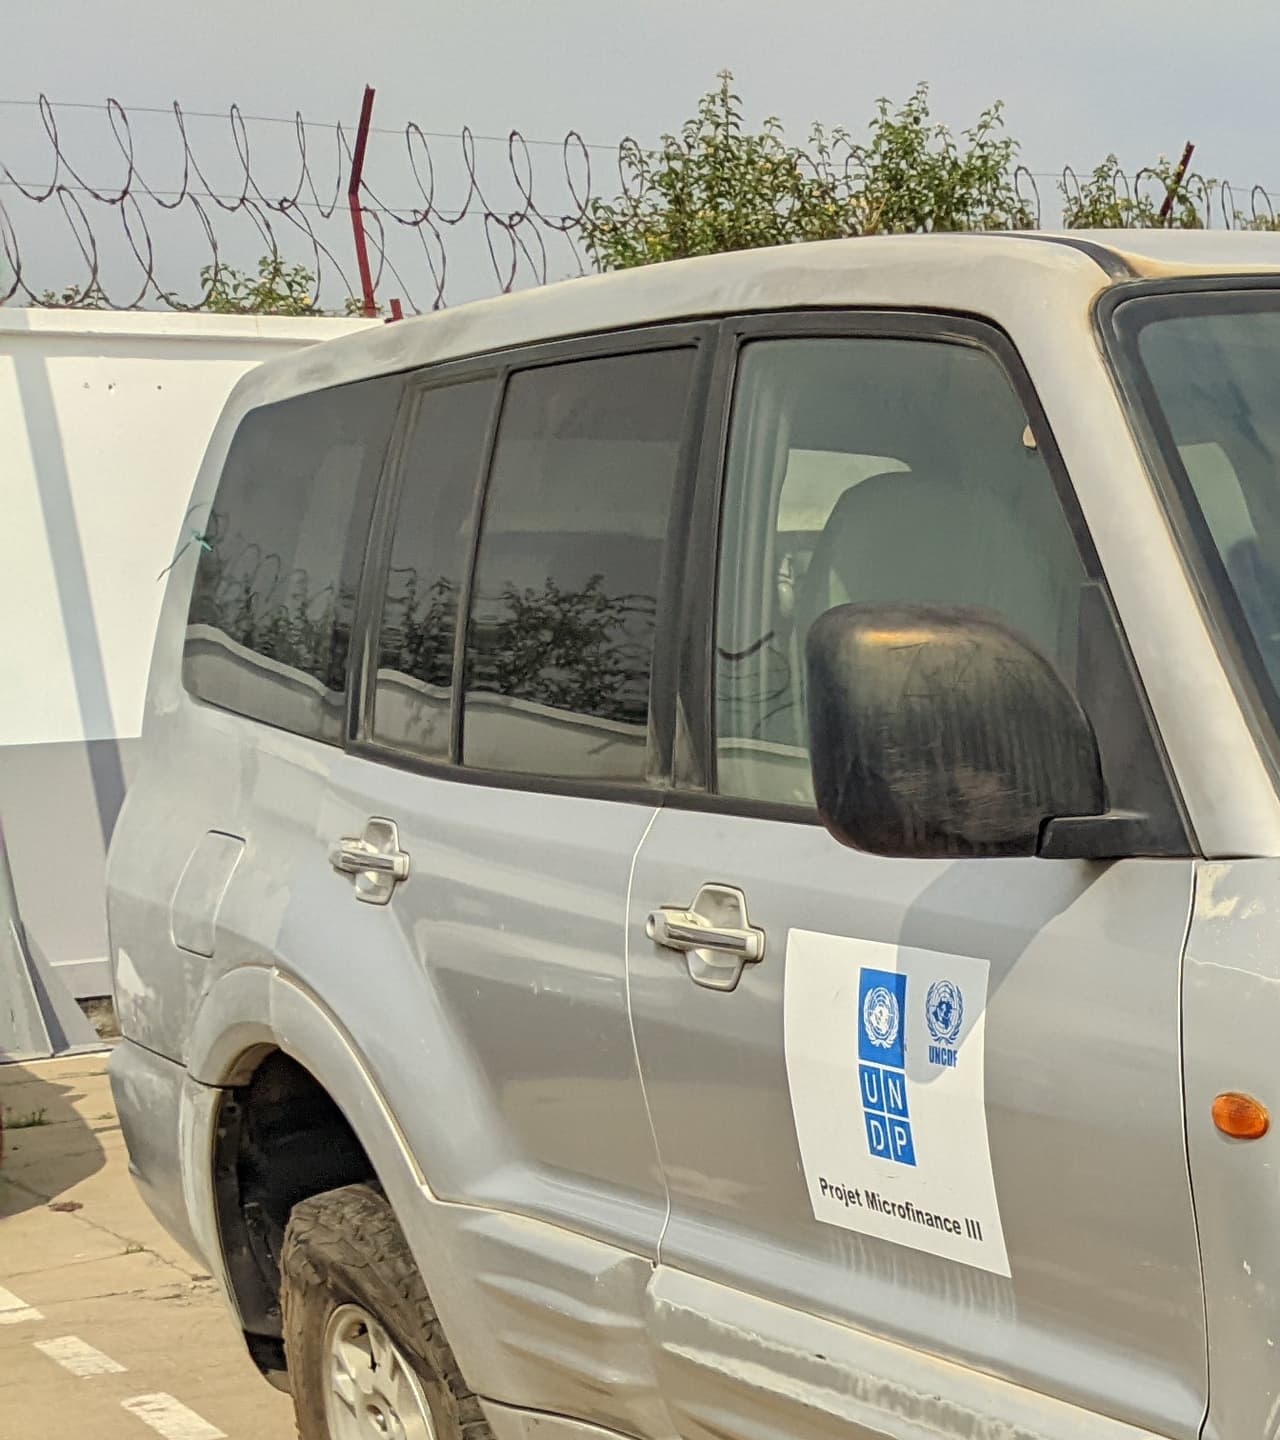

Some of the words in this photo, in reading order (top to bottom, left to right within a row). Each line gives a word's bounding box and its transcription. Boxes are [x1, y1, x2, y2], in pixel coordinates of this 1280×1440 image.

[929, 1046, 957, 1067] UNCDF
[819, 1177, 862, 1207] Projet
[864, 1190, 962, 1235] Microfinance
[966, 1220, 983, 1241] III
